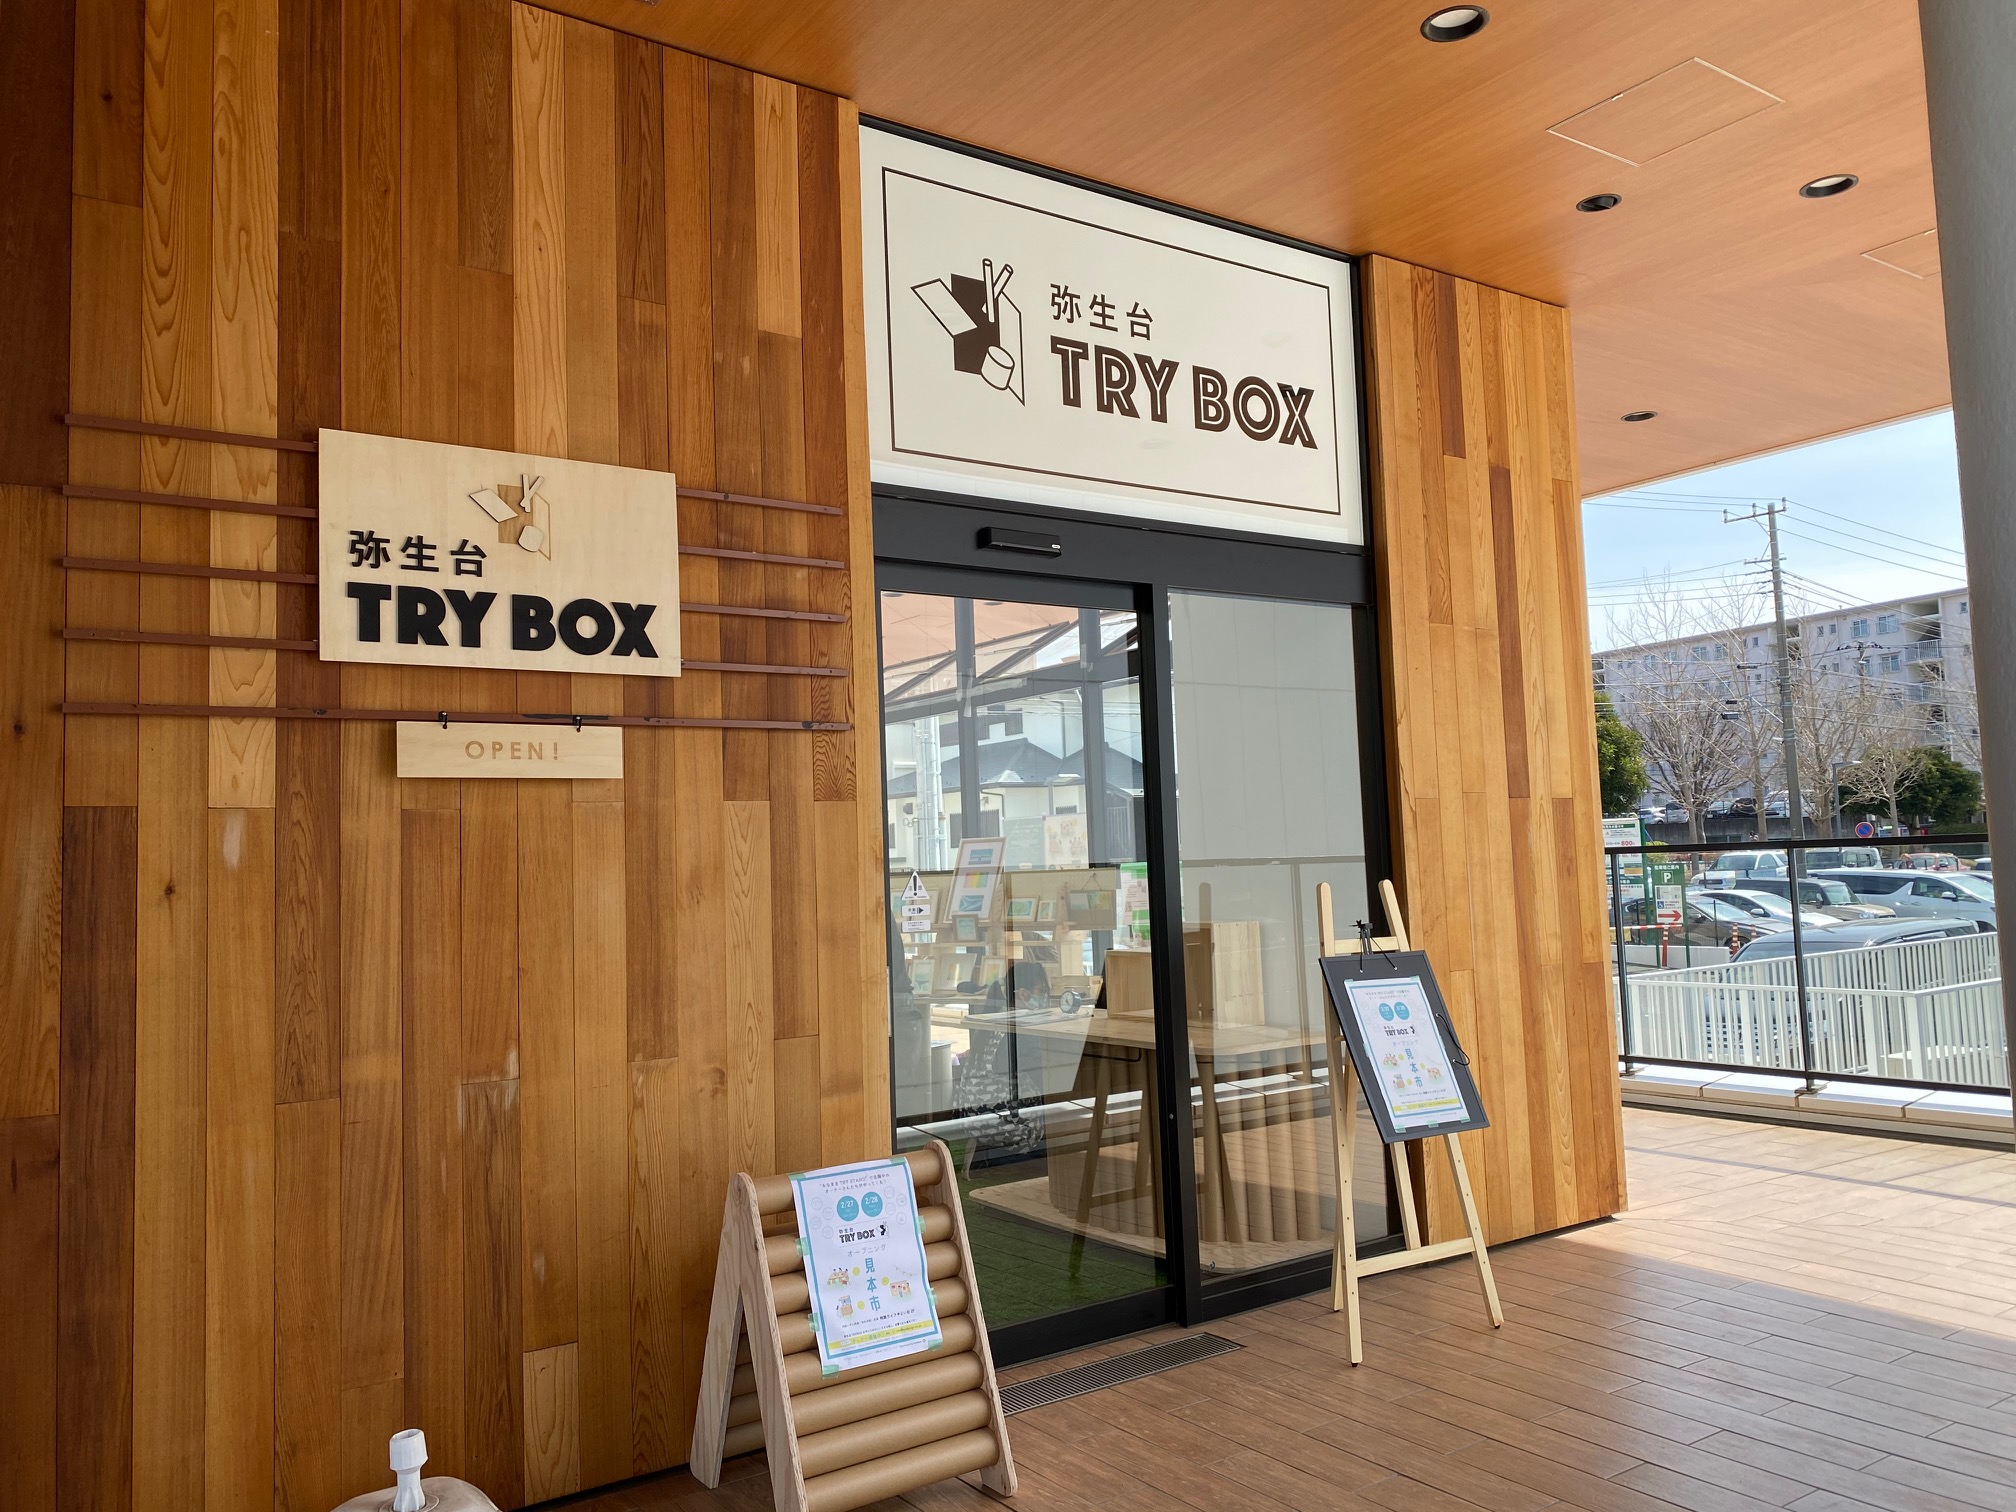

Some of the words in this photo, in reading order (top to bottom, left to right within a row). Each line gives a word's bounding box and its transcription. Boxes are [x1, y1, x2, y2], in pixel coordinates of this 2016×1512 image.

[1050, 283, 1154, 341] 弥生台
[1050, 334, 1179, 424] TRY
[1192, 364, 1319, 450] BOX
[348, 530, 487, 577] 弥生台
[347, 581, 498, 648] TRY
[511, 594, 659, 658] BOX
[464, 740, 559, 761] OPEN!
[1663, 872, 1672, 883] P
[839, 1232, 856, 1244] TRY
[856, 1228, 876, 1241] BOX
[847, 1243, 886, 1257] オープニング
[864, 1257, 881, 1312] 見本市
